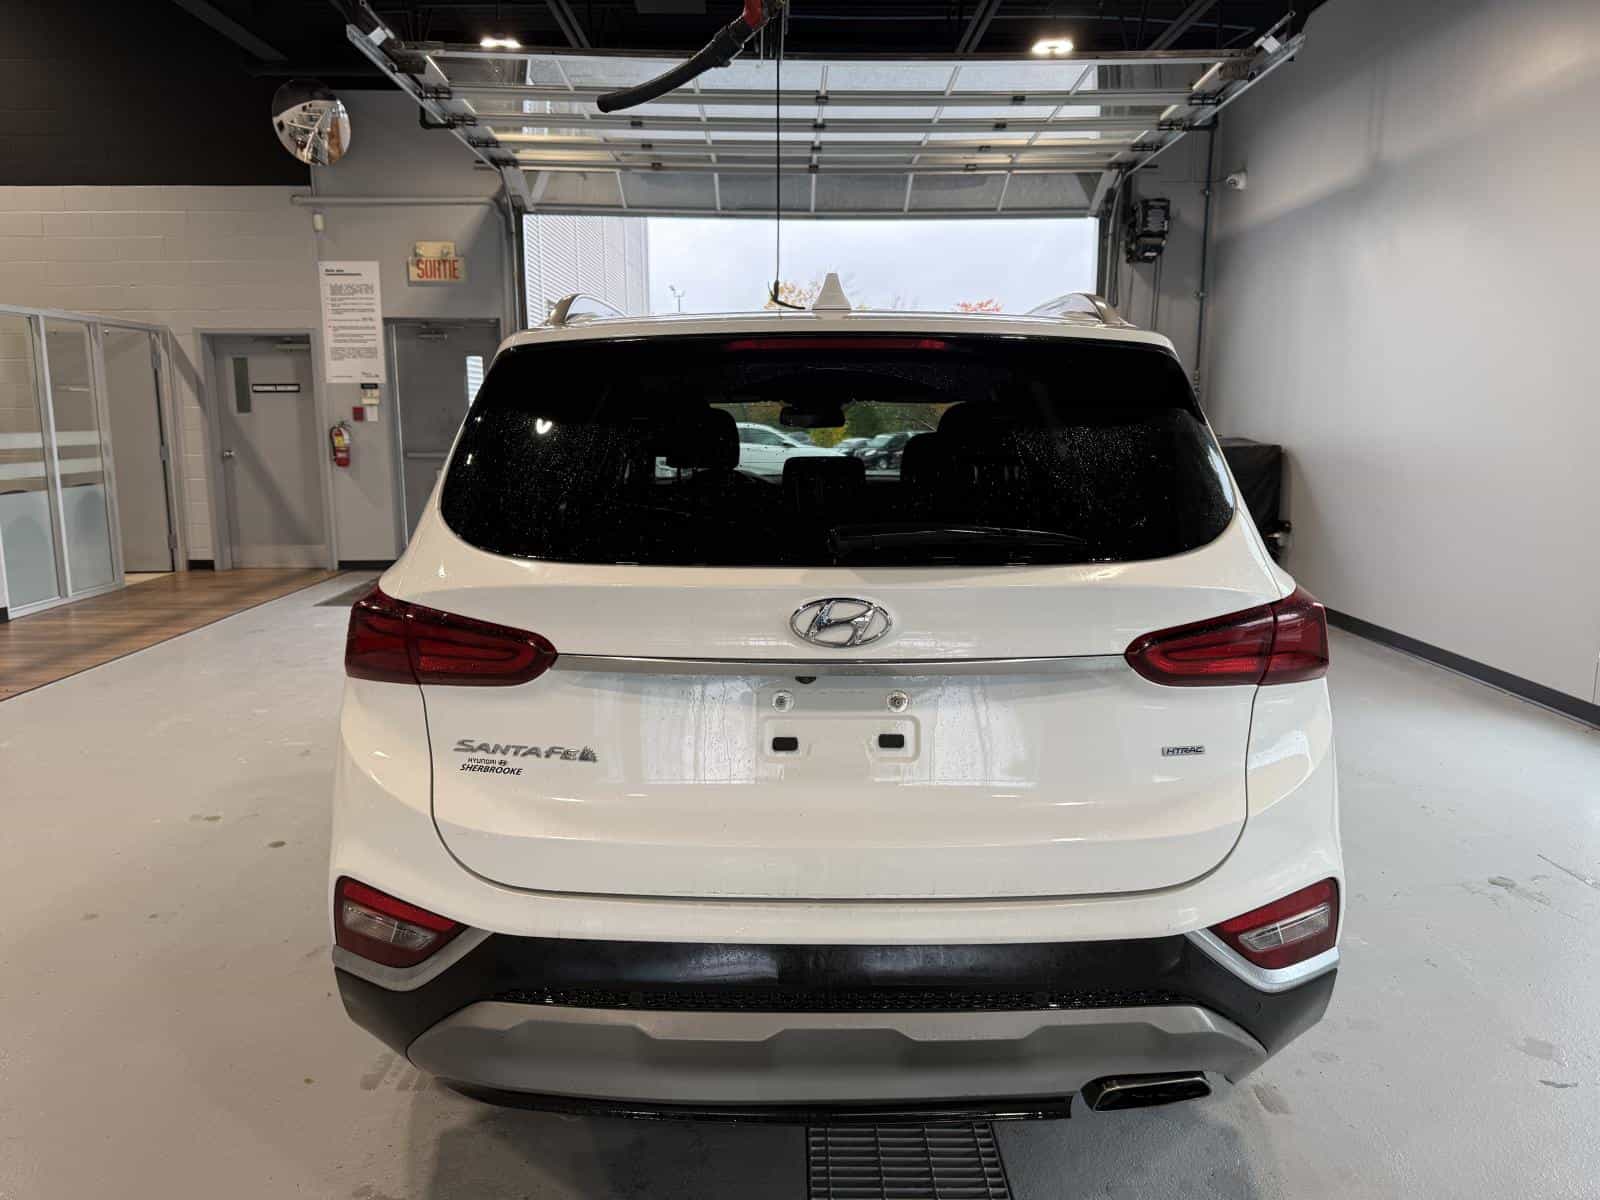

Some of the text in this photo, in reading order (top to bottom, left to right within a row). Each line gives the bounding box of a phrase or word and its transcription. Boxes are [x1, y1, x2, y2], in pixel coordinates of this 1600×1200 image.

[416, 258, 459, 279] SORTIE
[453, 738, 542, 759] SANTA
[1166, 746, 1205, 756] HTRAC
[467, 757, 497, 765] HYUNDAI
[459, 763, 523, 776] SHERBROOKE
